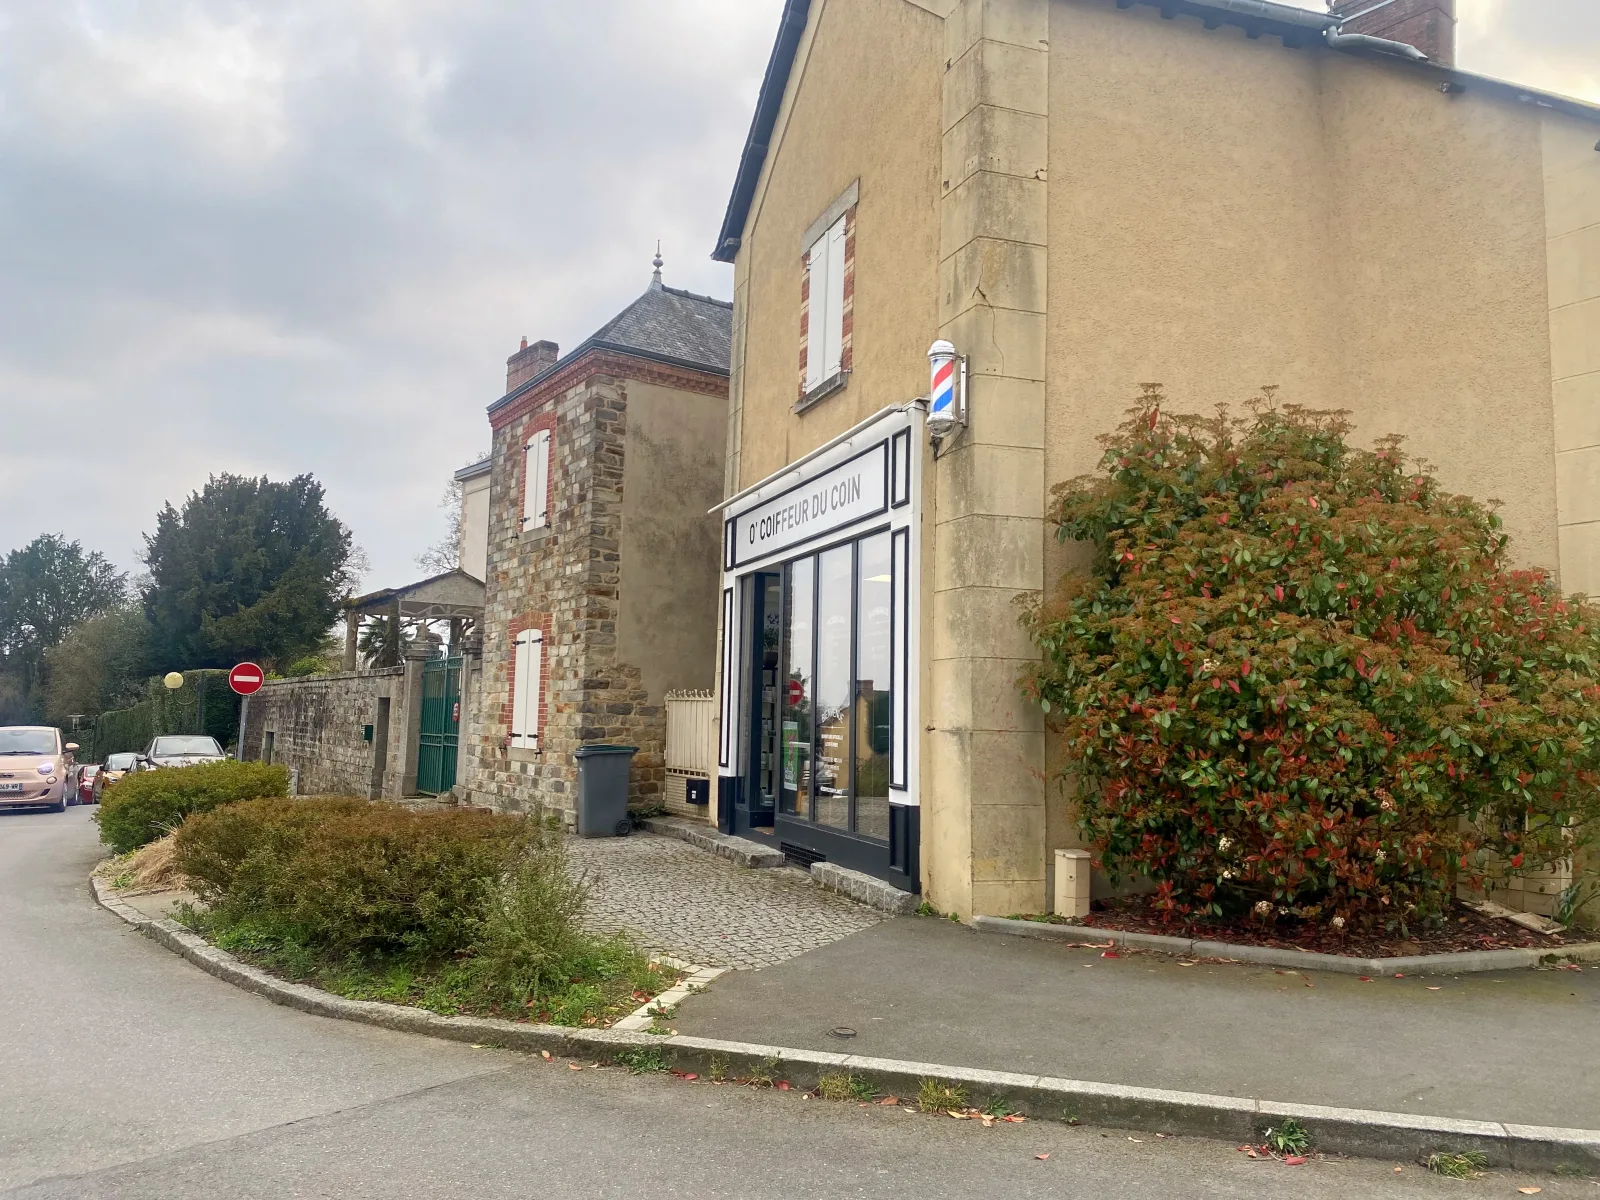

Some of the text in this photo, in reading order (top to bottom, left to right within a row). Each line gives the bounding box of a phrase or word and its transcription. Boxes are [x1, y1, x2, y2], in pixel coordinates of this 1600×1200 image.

[750, 473, 861, 545] O' COIFFEUR DU COIN
